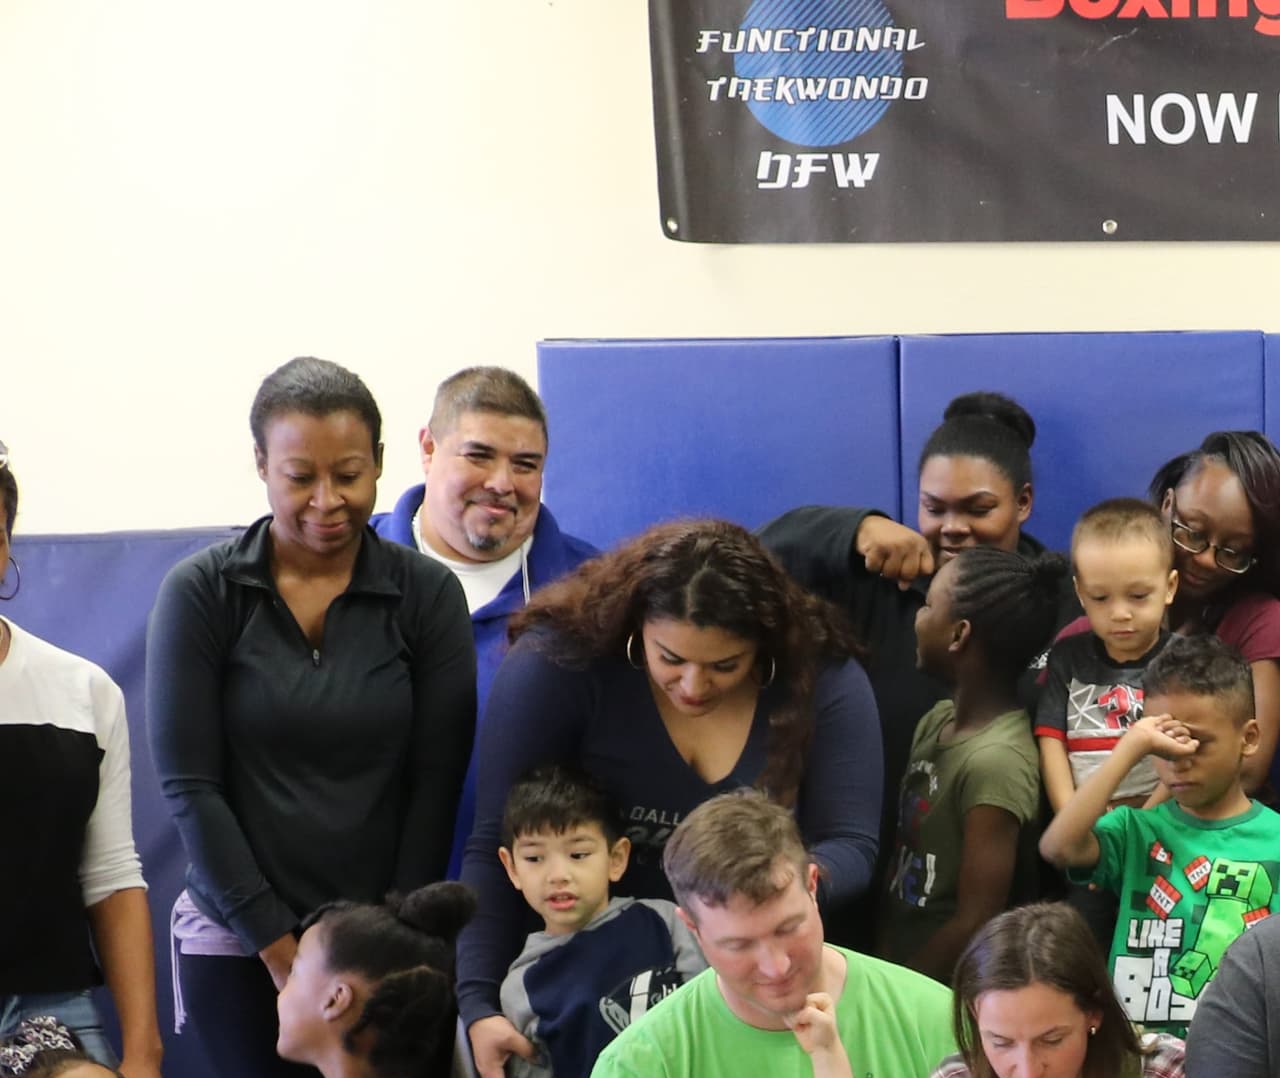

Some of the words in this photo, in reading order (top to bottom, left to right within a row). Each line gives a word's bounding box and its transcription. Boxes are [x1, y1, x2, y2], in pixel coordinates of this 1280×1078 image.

[696, 26, 925, 53] FUNCTIONAL
[707, 75, 929, 105] TAEKWONDO
[1106, 93, 1258, 145] NOW
[756, 151, 880, 189] DFW
[629, 806, 682, 826] DALL
[1189, 864, 1210, 882] TNT
[1152, 886, 1173, 909] TNT
[1127, 918, 1184, 948] LIKE
